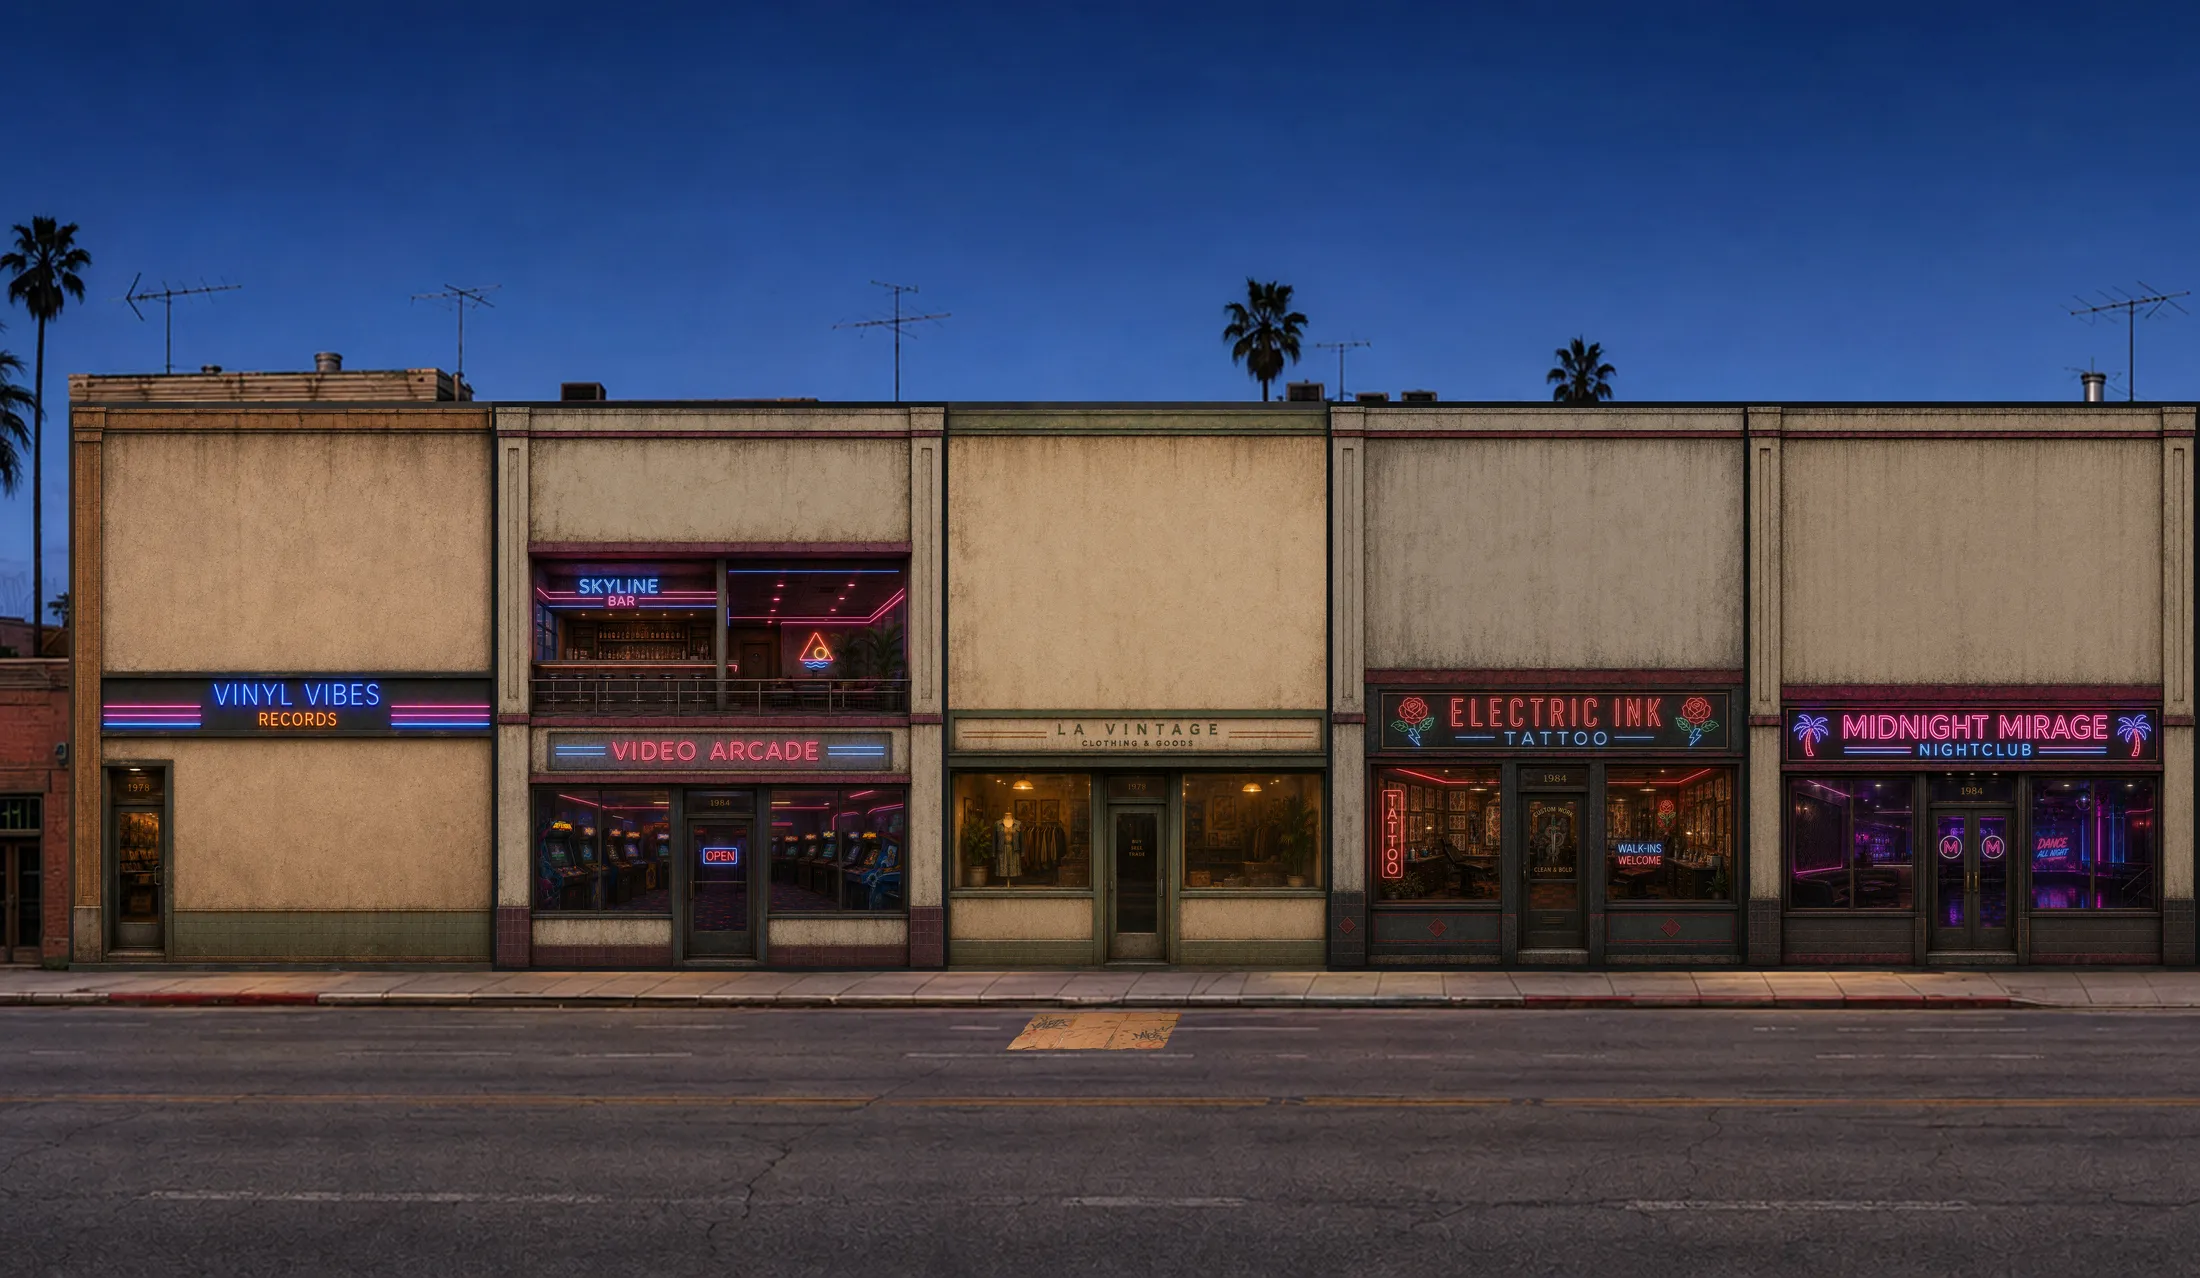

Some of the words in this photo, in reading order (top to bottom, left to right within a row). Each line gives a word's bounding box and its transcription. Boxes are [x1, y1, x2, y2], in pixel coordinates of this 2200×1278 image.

[579, 578, 659, 594] SKYLINE
[608, 595, 635, 607] BAR
[213, 683, 293, 706] VINYL
[305, 683, 380, 706] VIBES
[1451, 697, 1599, 728] ELECTRIC
[1614, 697, 1662, 728] INK
[258, 712, 337, 727] RECORDS
[1057, 723, 1085, 736] LA
[1105, 723, 1219, 736] VINTAGE
[1843, 714, 1989, 740] MIDNIGHT
[1999, 714, 2108, 740] MIRAGE
[1504, 731, 1608, 746] TATTOO
[612, 741, 697, 761] VIDEO
[709, 741, 820, 761] ARCADE
[1919, 743, 2032, 757] NIGHTCLUB
[1543, 774, 1567, 783] 1984
[127, 783, 150, 792] 1978
[1128, 783, 1147, 791] 1978
[1960, 787, 1983, 795] 1984
[710, 799, 730, 807] 1984
[1532, 806, 1557, 818] CUSTOM
[1558, 806, 1574, 818] WORK
[1387, 794, 1398, 875] TATTOO
[1617, 843, 1662, 854] WALK-INS
[1943, 840, 1958, 854] M
[1985, 840, 2000, 854] M
[2037, 837, 2068, 850] DANCE
[706, 851, 735, 862] OPEN
[2037, 849, 2049, 858] ALL
[2050, 848, 2070, 857] NIGHT
[1617, 855, 1662, 865] WELCOME
